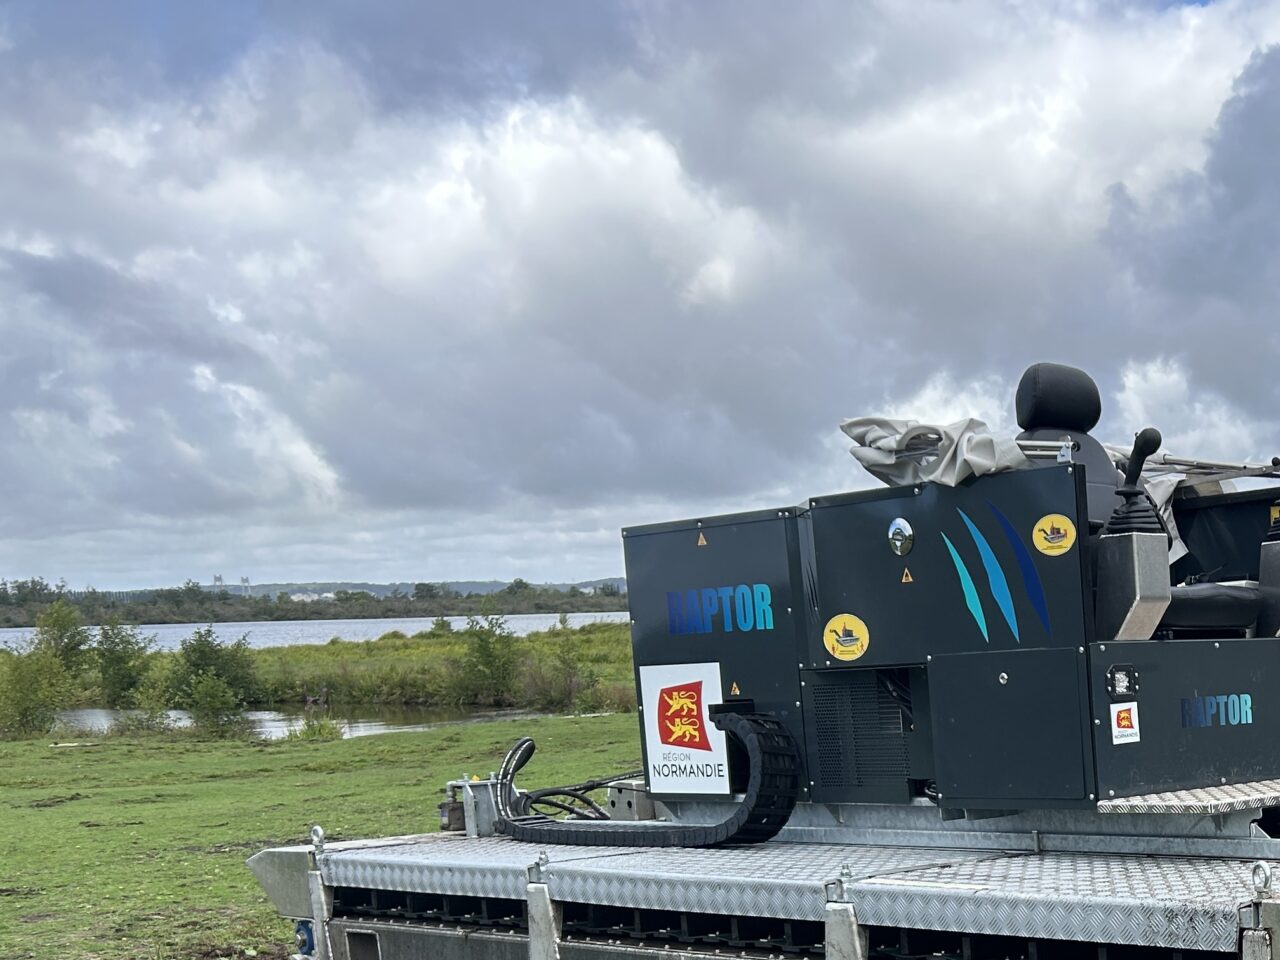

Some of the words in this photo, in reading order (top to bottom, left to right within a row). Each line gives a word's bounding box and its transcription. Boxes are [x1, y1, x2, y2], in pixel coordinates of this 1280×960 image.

[666, 583, 774, 636] RAPTOR
[1180, 694, 1253, 728] RAPTOR
[663, 752, 691, 762] RÉGION
[653, 763, 725, 778] NORMANDIE
